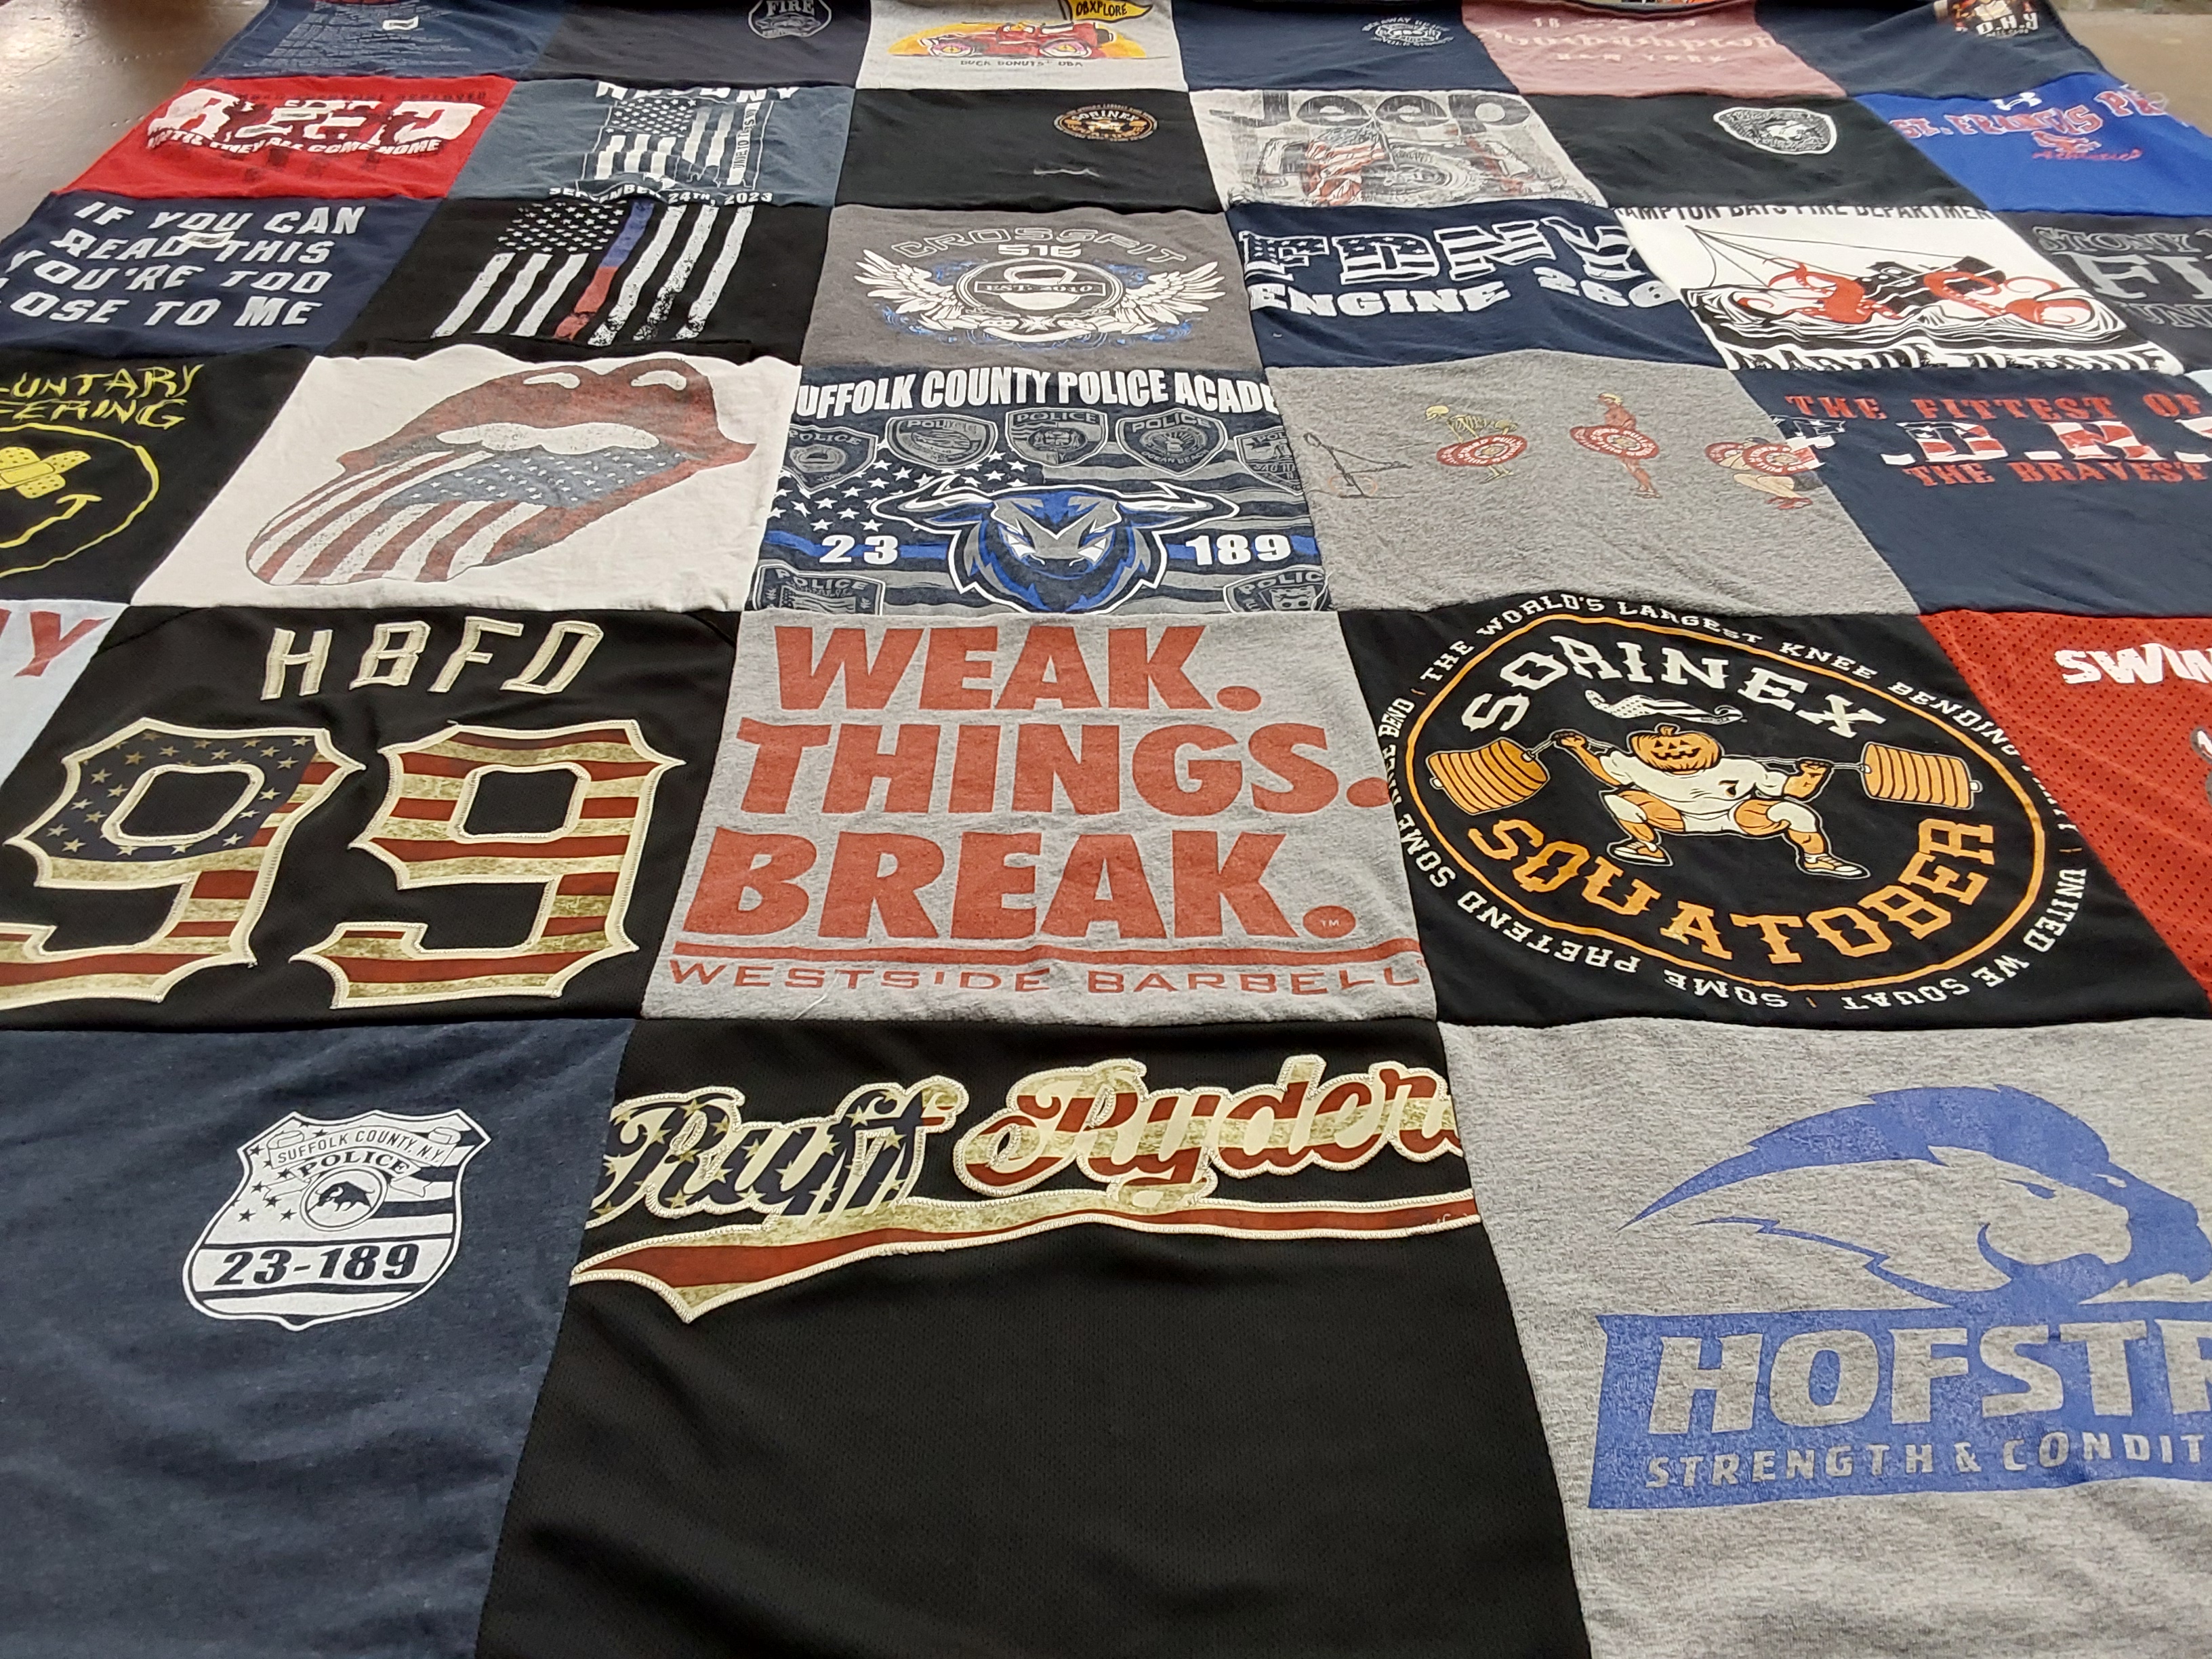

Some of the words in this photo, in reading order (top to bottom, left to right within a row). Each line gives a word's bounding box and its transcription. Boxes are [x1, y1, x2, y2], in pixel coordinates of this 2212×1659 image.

[766, 0, 815, 16] FIRE
[1076, 3, 1127, 16] OBXPLORE
[1944, 104, 2103, 136] FRANCIS
[209, 140, 266, 153] THEY
[307, 141, 375, 153] COME
[375, 140, 441, 155] HOME
[723, 192, 773, 204] 2023
[74, 202, 134, 226] IF
[148, 212, 253, 230] YOU
[264, 206, 367, 235] CAN
[50, 228, 192, 257] READ
[215, 240, 335, 264] THIS
[891, 228, 1187, 262] CROSSFIT
[998, 244, 1081, 258] 516
[1239, 217, 1645, 285] FDNY
[2033, 226, 2203, 252] STONY
[7, 249, 205, 291] YOU'RE
[220, 271, 332, 293] TOO
[2052, 251, 2212, 300] FI
[0, 286, 129, 323] OSE
[144, 300, 221, 325] TO
[234, 296, 323, 326] ME
[1248, 281, 1511, 316] ENGINE
[0, 364, 203, 398] UNTARY
[796, 374, 916, 419] UFFOLK
[921, 365, 1050, 407] COUNTY
[1059, 369, 1170, 407] POLICE
[1017, 412, 1096, 424] POLICE
[1132, 413, 1212, 432] POLICE
[1785, 396, 1887, 419] THE
[1911, 396, 2117, 419] FITTEST
[2144, 394, 2202, 416] OF
[788, 430, 861, 445] POLICE
[907, 420, 979, 434] POLICE
[1902, 464, 1995, 486] THE
[2008, 462, 2207, 482] BRAVEST
[820, 535, 898, 564] 23
[1186, 535, 1290, 565] 189
[775, 569, 868, 590] POLICE
[262, 616, 602, 699] HBFD
[773, 624, 1262, 711] WEAK.
[1420, 640, 1475, 681] THE
[1476, 594, 1605, 635] WORLD'S
[1618, 602, 1763, 644] LARGEST
[1779, 642, 1878, 680] KNEE
[1887, 682, 2021, 756] BENDING
[1461, 635, 1886, 739] SORINEX
[1378, 698, 1416, 737] BEND
[737, 718, 1393, 815] THINGS.
[0, 719, 684, 1009] 99
[1397, 813, 1456, 888] SOME
[682, 826, 1357, 940] BREAK.
[1468, 818, 1995, 964] SQUATOBER
[2023, 869, 2087, 952] UNITED
[1457, 890, 1641, 974] PRETEND
[672, 960, 1051, 994] WESTSIDE
[1086, 965, 1419, 996] BARBELL
[1664, 969, 1789, 1008] SOME
[1971, 955, 2030, 988] WE
[1841, 979, 1971, 1010] SQUAT
[277, 1131, 349, 1164] SUFFOLK
[355, 1129, 418, 1153] COUNTY,
[416, 1144, 445, 1164] N.Y.
[586, 1076, 967, 1230] Ruff
[298, 1151, 410, 1178] POLICE
[213, 1243, 420, 1286] 23-189
[1645, 1442, 1941, 1490] STRENGTH
[1954, 1441, 1981, 1475] &
[2002, 1431, 2205, 1475] CONDIT
